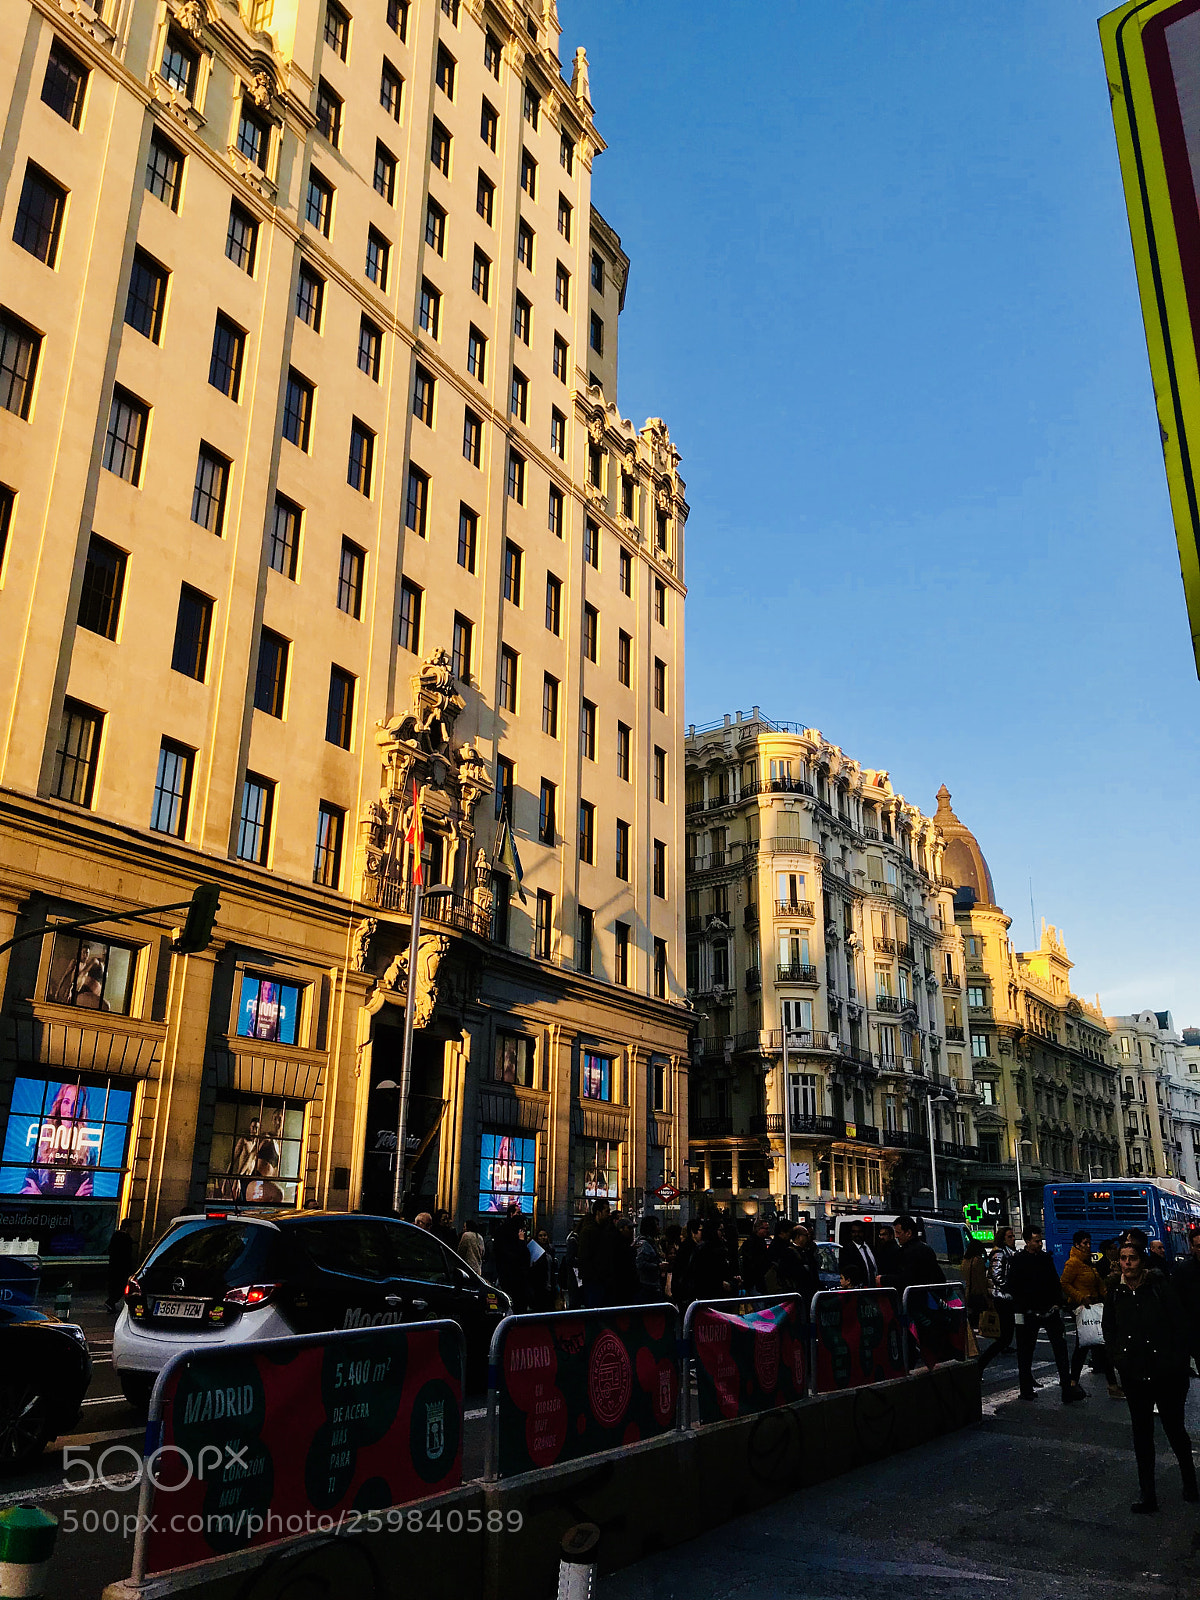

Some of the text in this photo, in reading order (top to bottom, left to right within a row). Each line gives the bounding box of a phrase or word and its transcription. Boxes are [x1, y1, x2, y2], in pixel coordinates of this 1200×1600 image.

[40, 1214, 72, 1229] Digital
[160, 1303, 180, 1315] 3661
[510, 1345, 551, 1372] MADRID
[333, 1358, 372, 1390] 5.400
[183, 1384, 254, 1425] MADRID
[332, 1402, 370, 1424] DE ACERA
[329, 1450, 351, 1470] PARA
[217, 1486, 243, 1509] MUY
